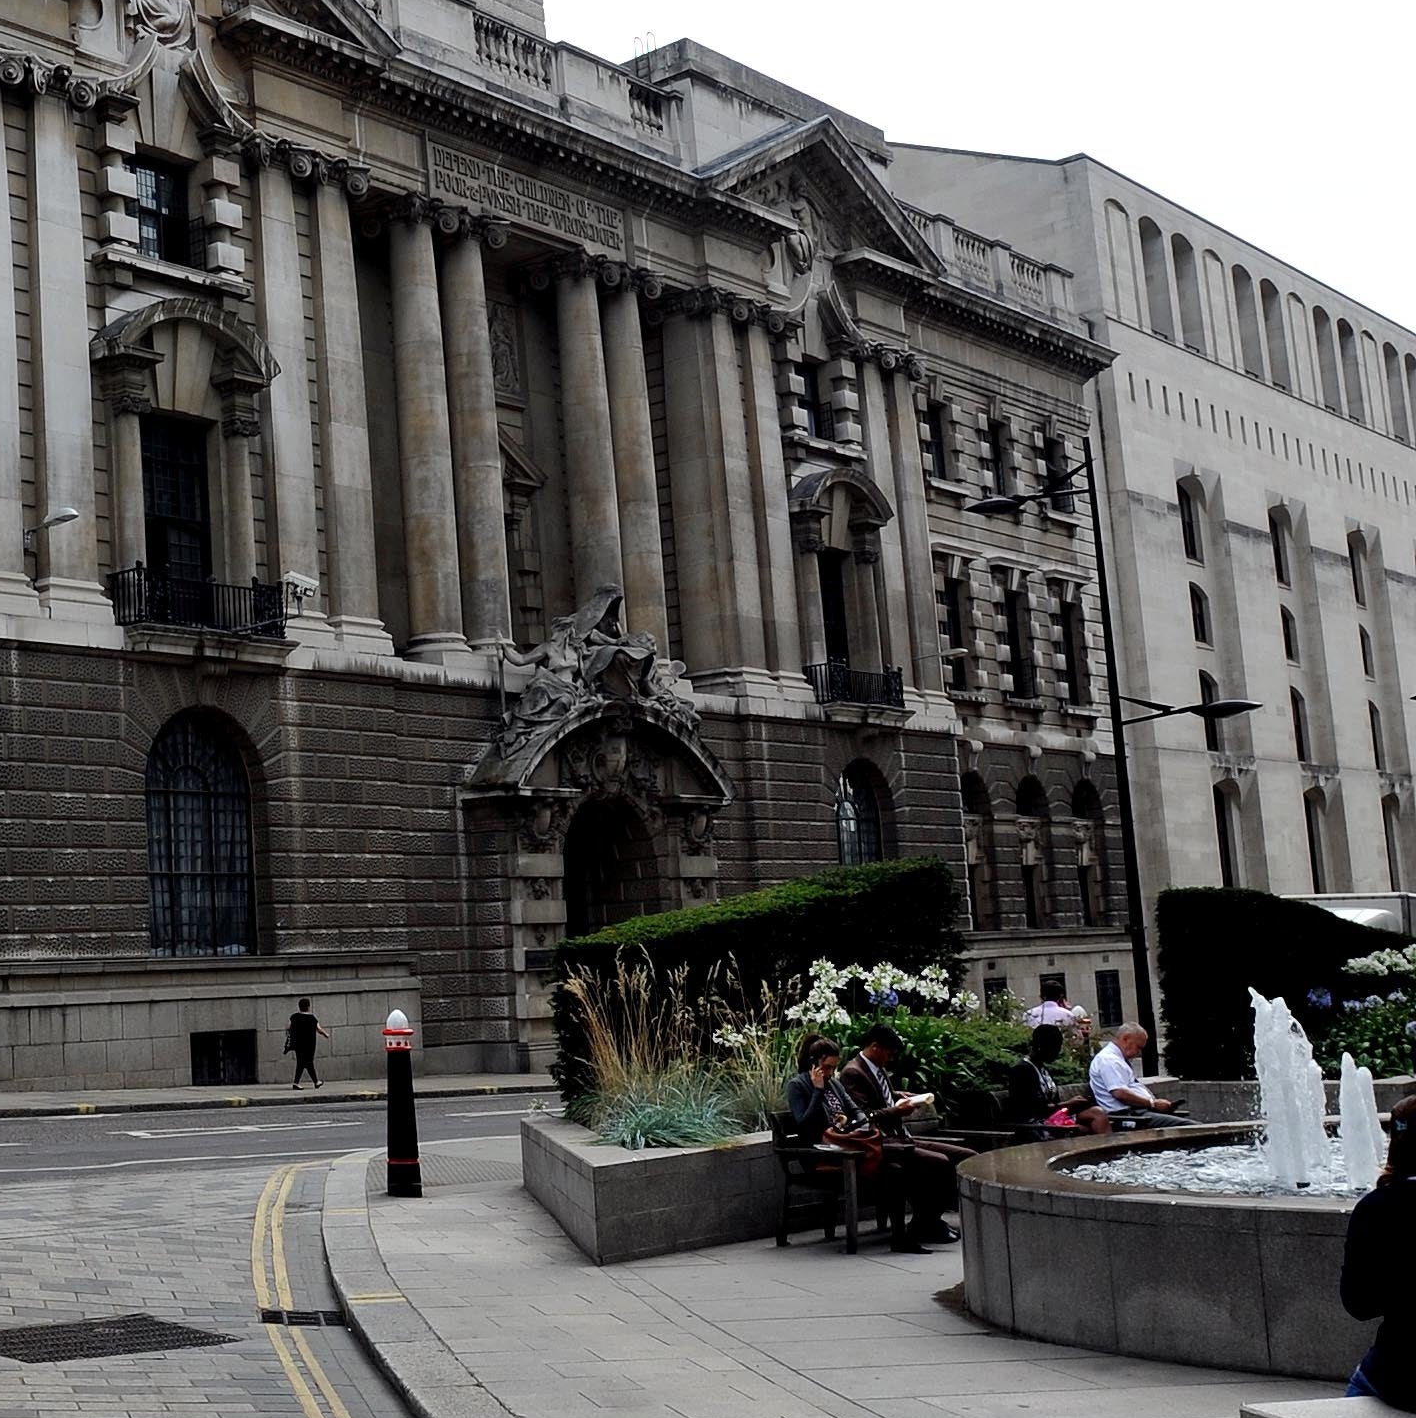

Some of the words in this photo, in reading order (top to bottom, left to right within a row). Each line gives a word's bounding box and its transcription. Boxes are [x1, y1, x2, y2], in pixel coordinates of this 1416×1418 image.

[433, 146, 481, 180] DEFEND
[485, 165, 510, 191] THE
[514, 176, 571, 214] CHILDREN
[576, 198, 592, 219] OF
[595, 205, 618, 230] THE
[434, 169, 469, 199] POOR
[524, 201, 549, 227] THE
